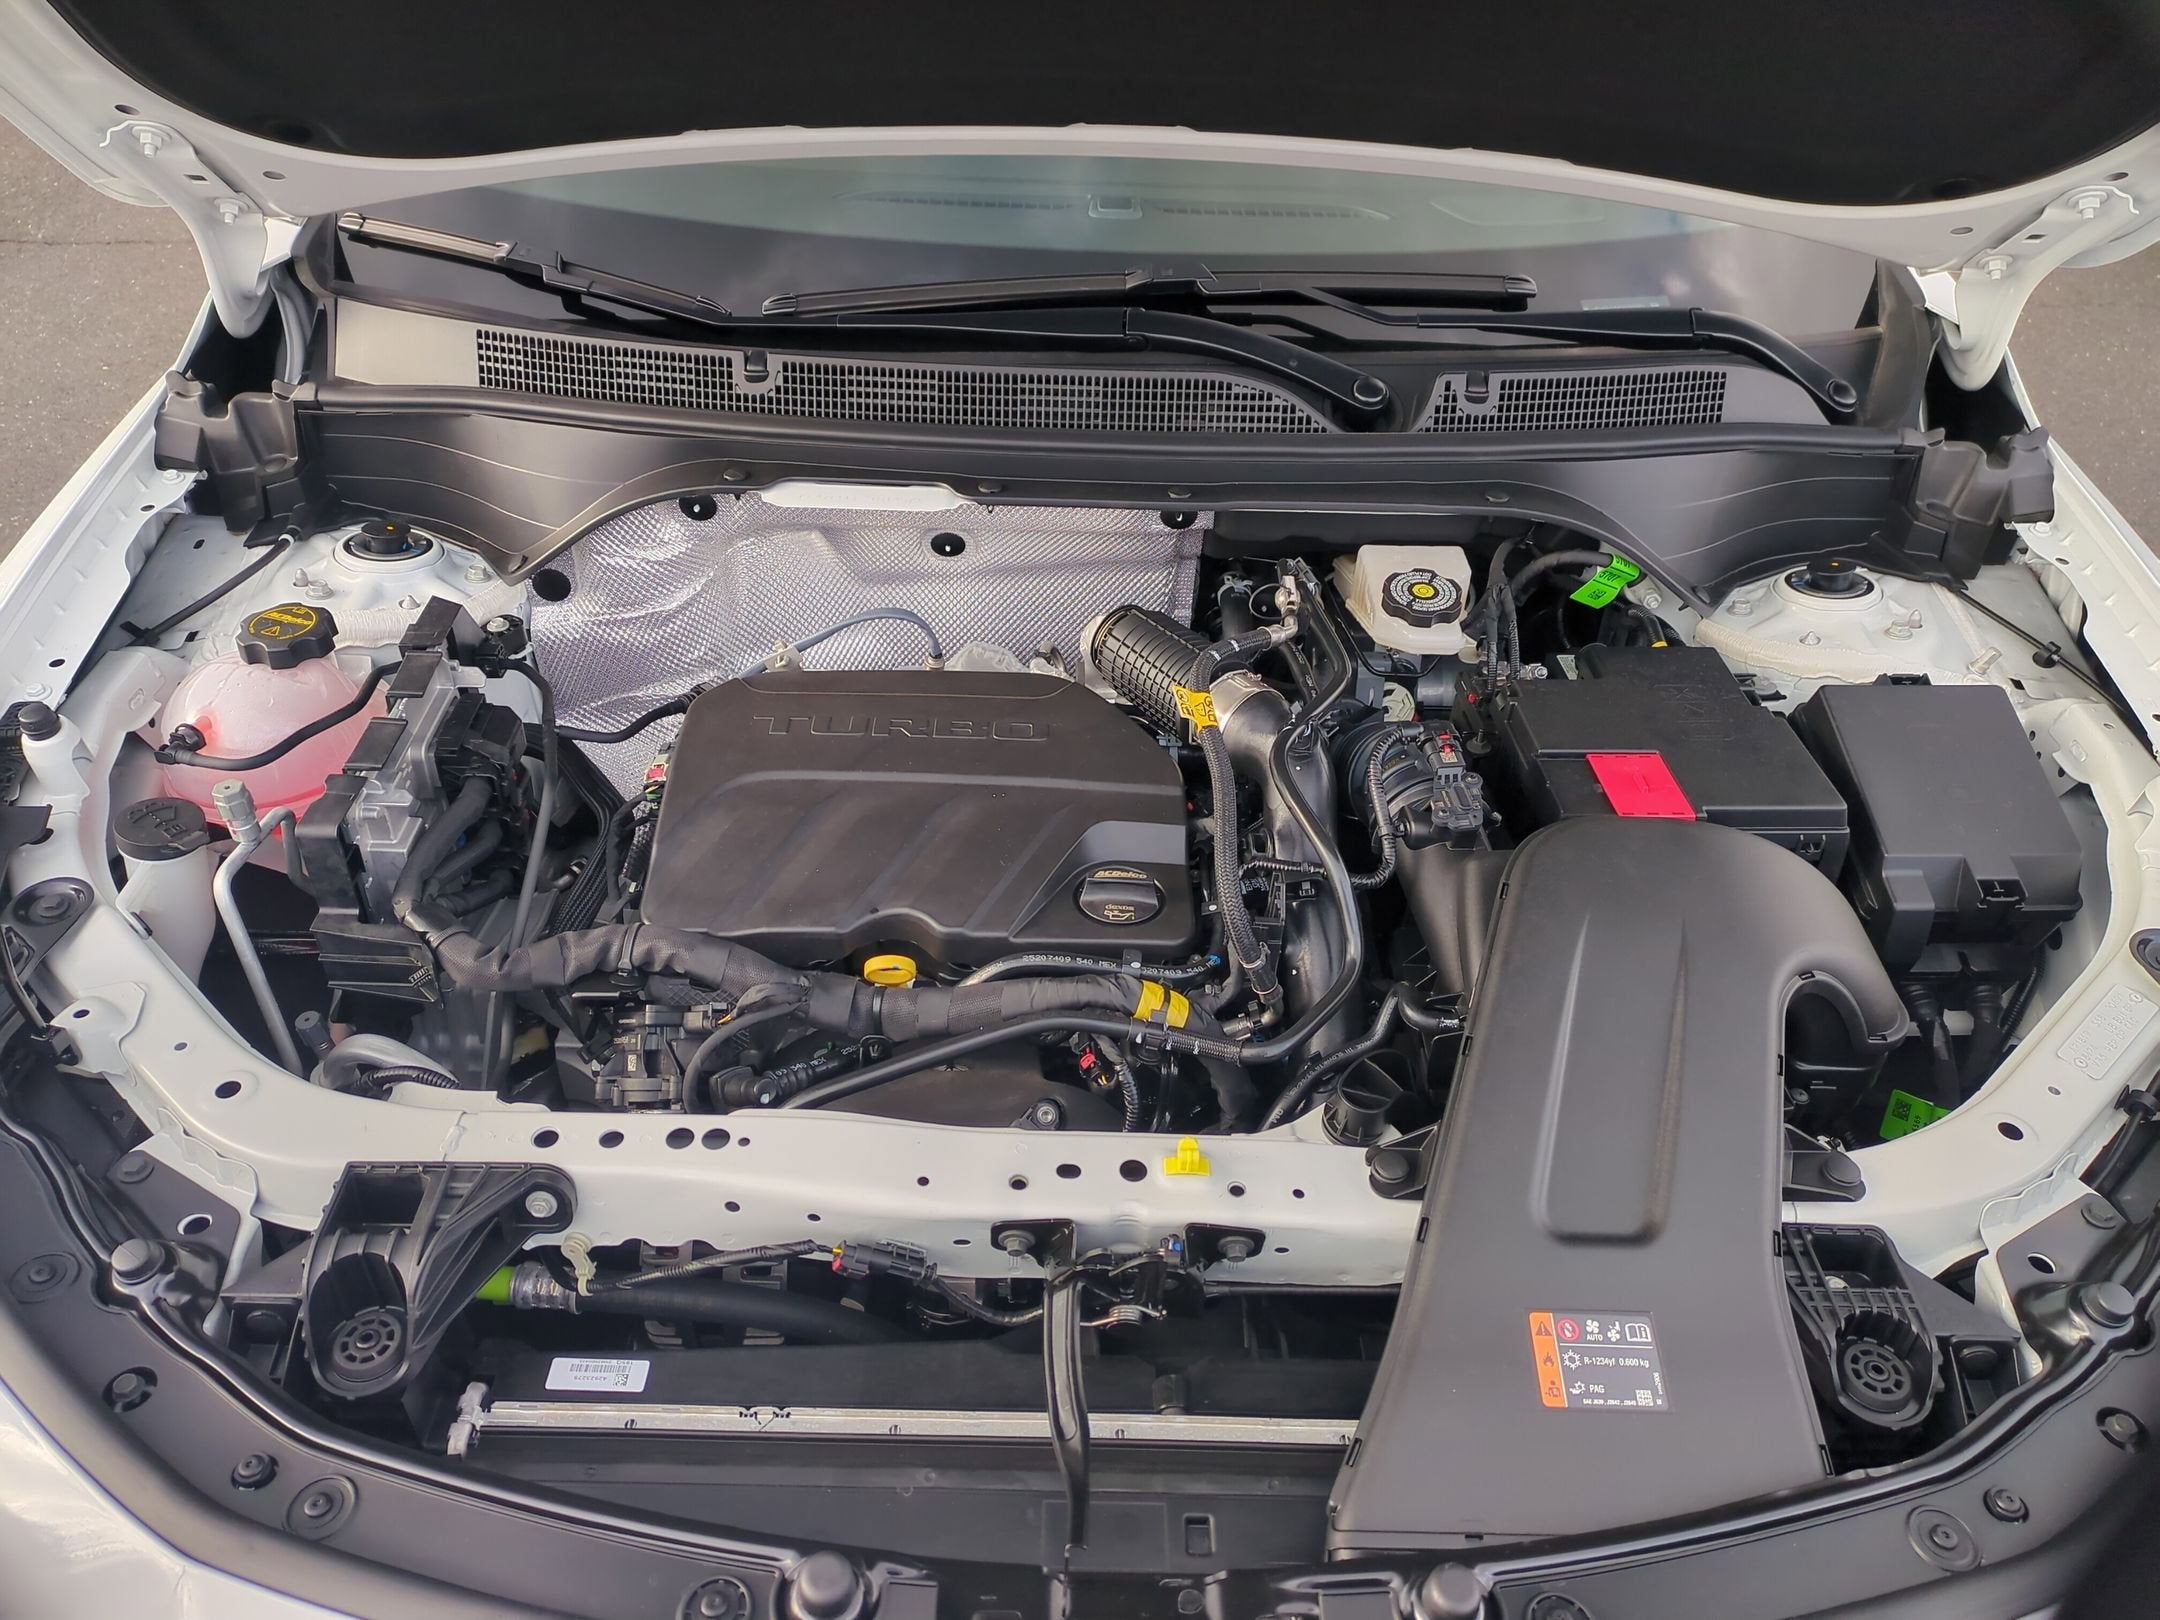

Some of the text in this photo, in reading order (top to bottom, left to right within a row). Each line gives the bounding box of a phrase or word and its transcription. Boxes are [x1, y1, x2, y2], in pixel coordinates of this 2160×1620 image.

[752, 715, 1050, 742] TURBO
[1093, 870, 1148, 879] ACDelco
[1076, 957, 1094, 966] 540
[1098, 960, 1117, 969] MEX
[1640, 1358, 1649, 1368] kg
[1589, 1384, 1605, 1393] PAG
